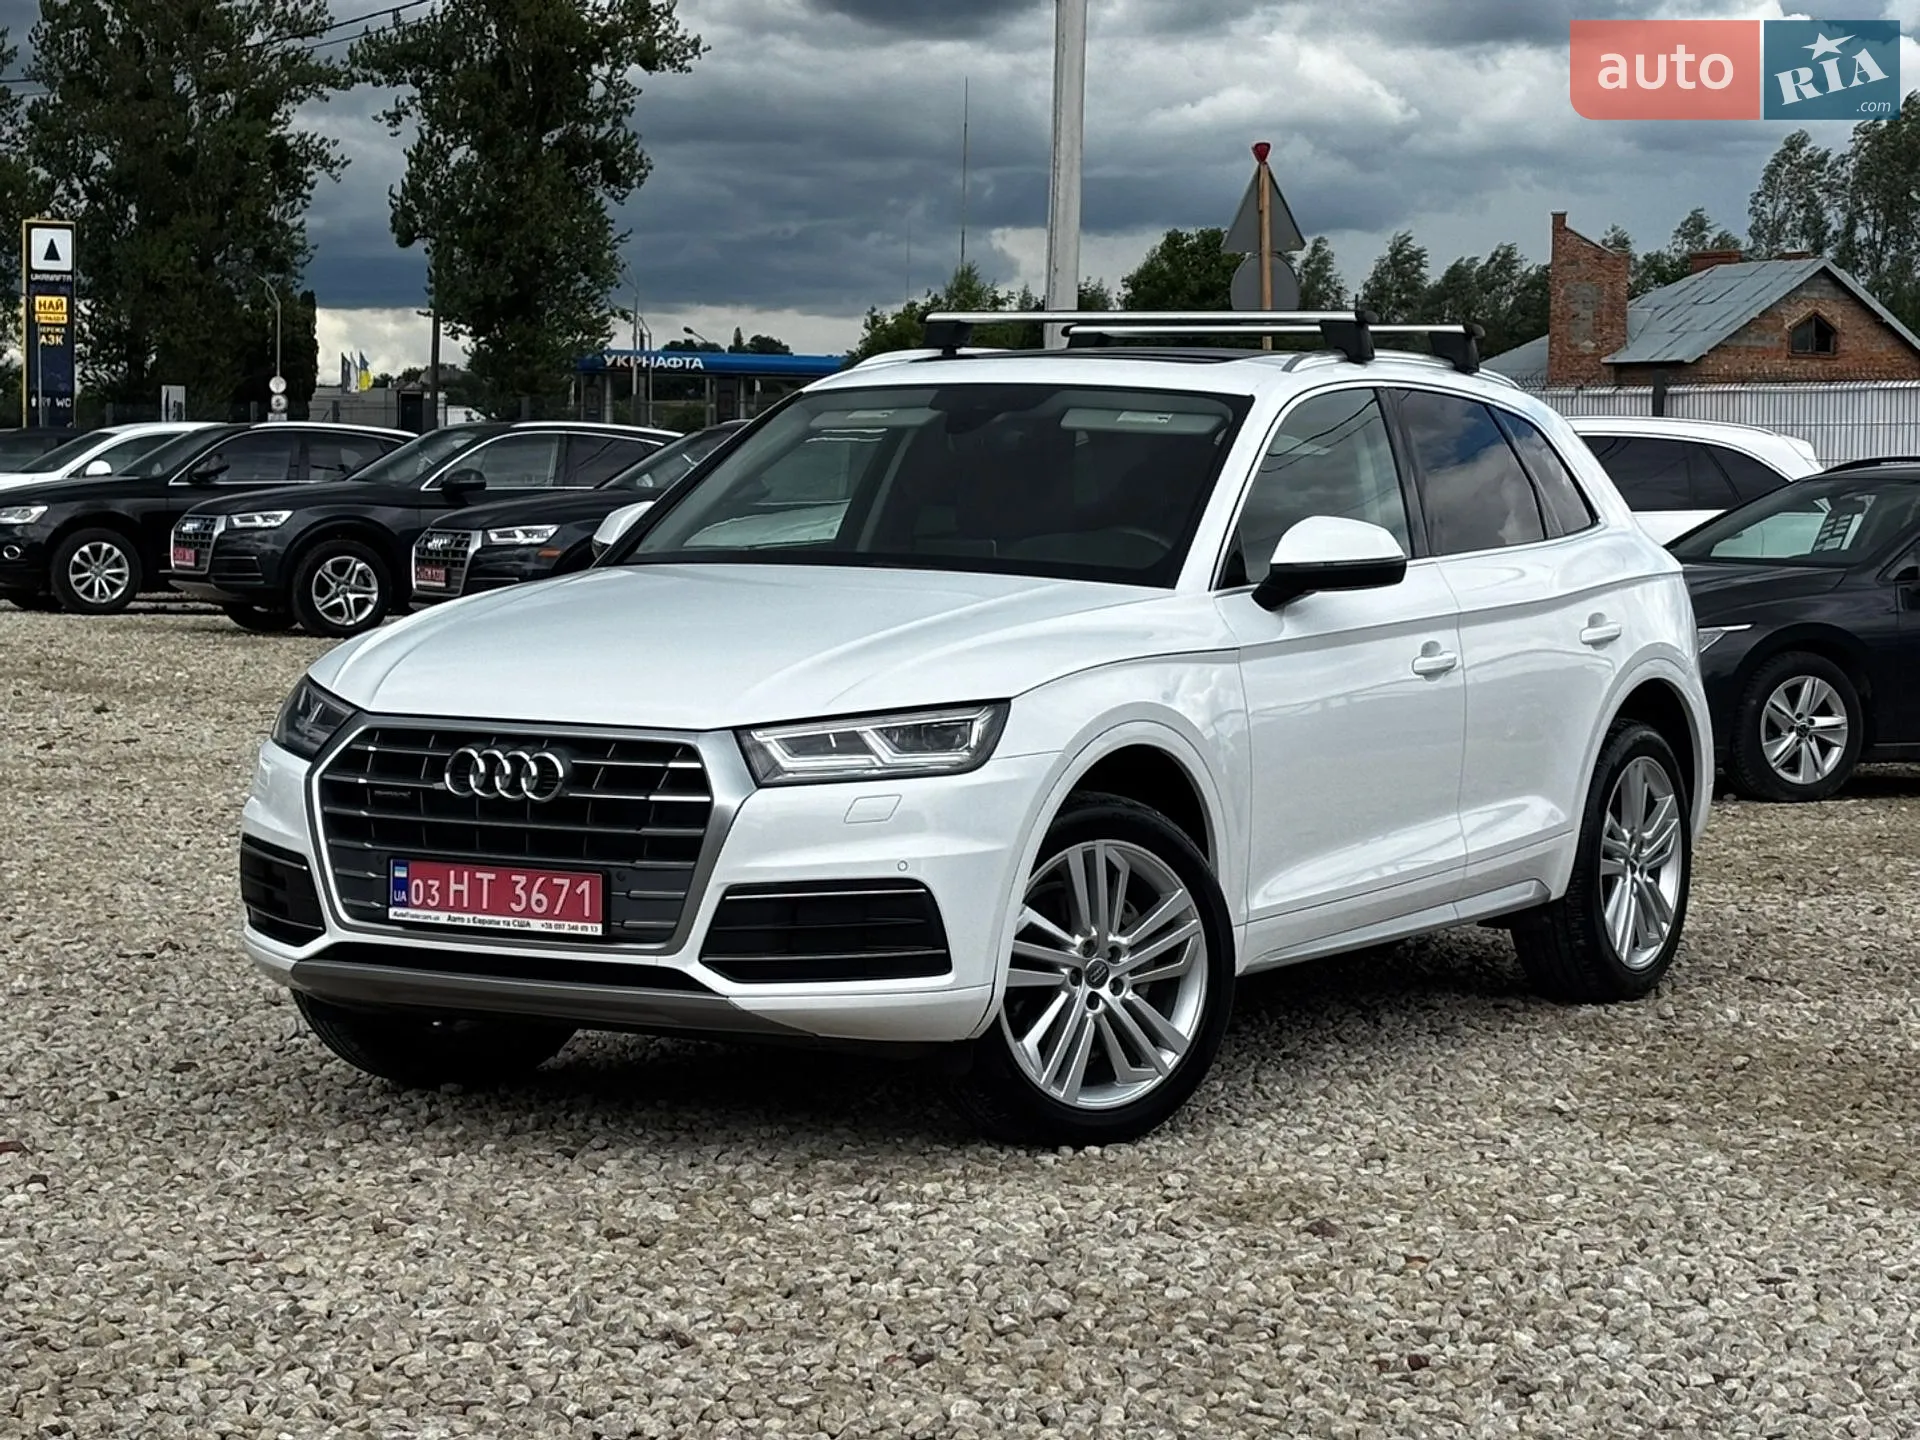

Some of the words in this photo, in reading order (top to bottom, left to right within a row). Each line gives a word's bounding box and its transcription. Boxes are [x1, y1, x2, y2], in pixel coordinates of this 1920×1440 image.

[38, 298, 64, 311] НАЙ
[39, 334, 64, 346] АЗК
[603, 354, 704, 370] УКРНАФТА
[55, 397, 72, 408] WC
[393, 889, 407, 903] UA
[411, 878, 440, 908] 03
[509, 874, 591, 918] 3671
[446, 914, 465, 923] Авто
[472, 916, 500, 926] Європи
[512, 919, 531, 928] США
